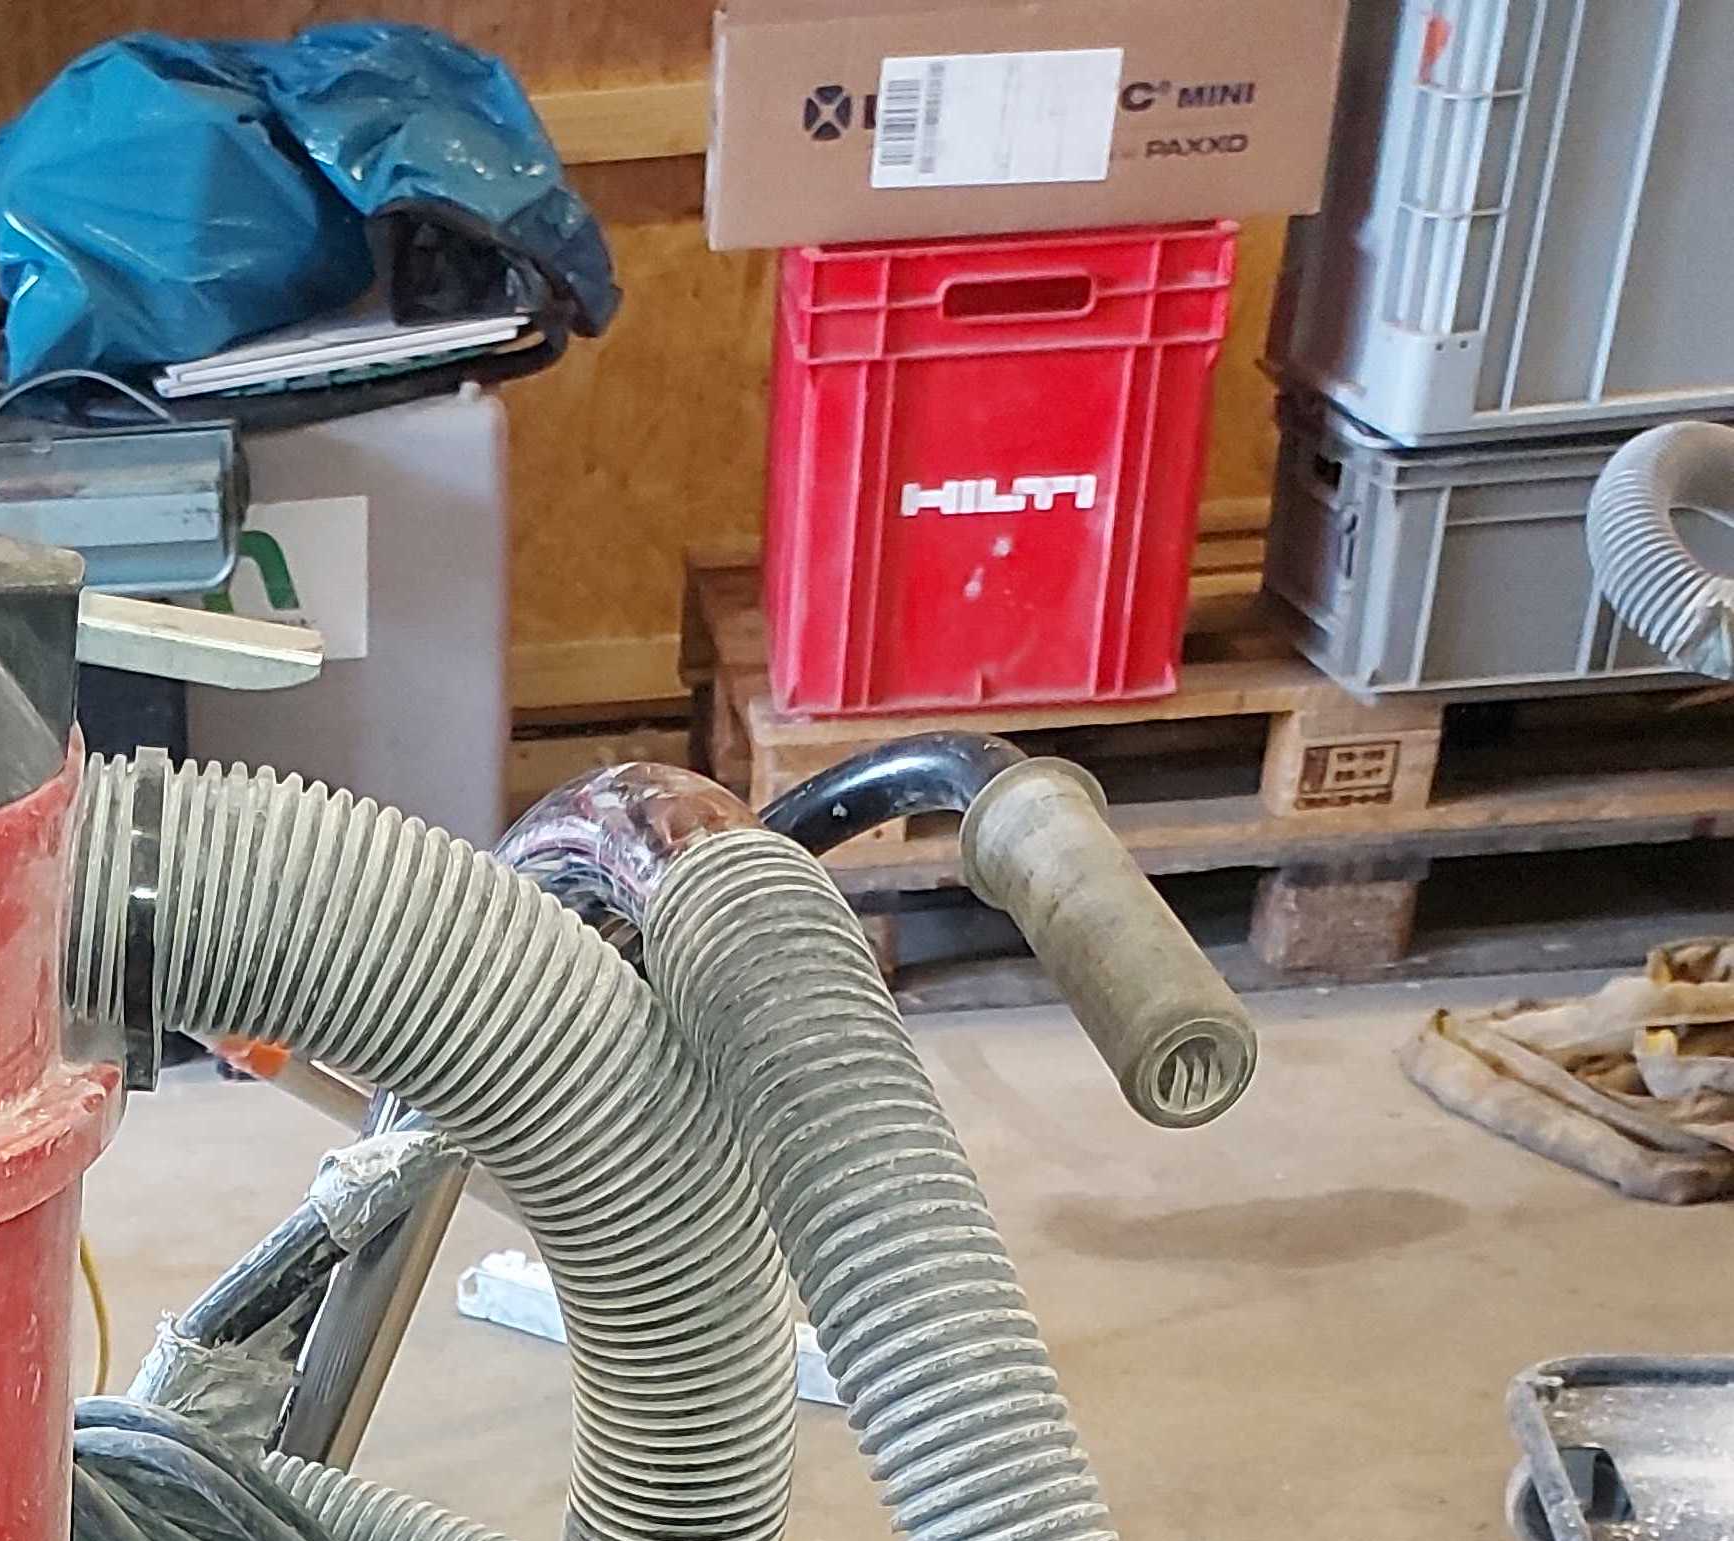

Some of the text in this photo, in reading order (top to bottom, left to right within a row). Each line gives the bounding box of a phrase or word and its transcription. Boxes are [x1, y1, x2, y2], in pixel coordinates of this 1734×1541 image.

[1177, 82, 1255, 108] MINI
[1145, 133, 1248, 158] PAXXO
[900, 473, 1097, 517] HILTI
